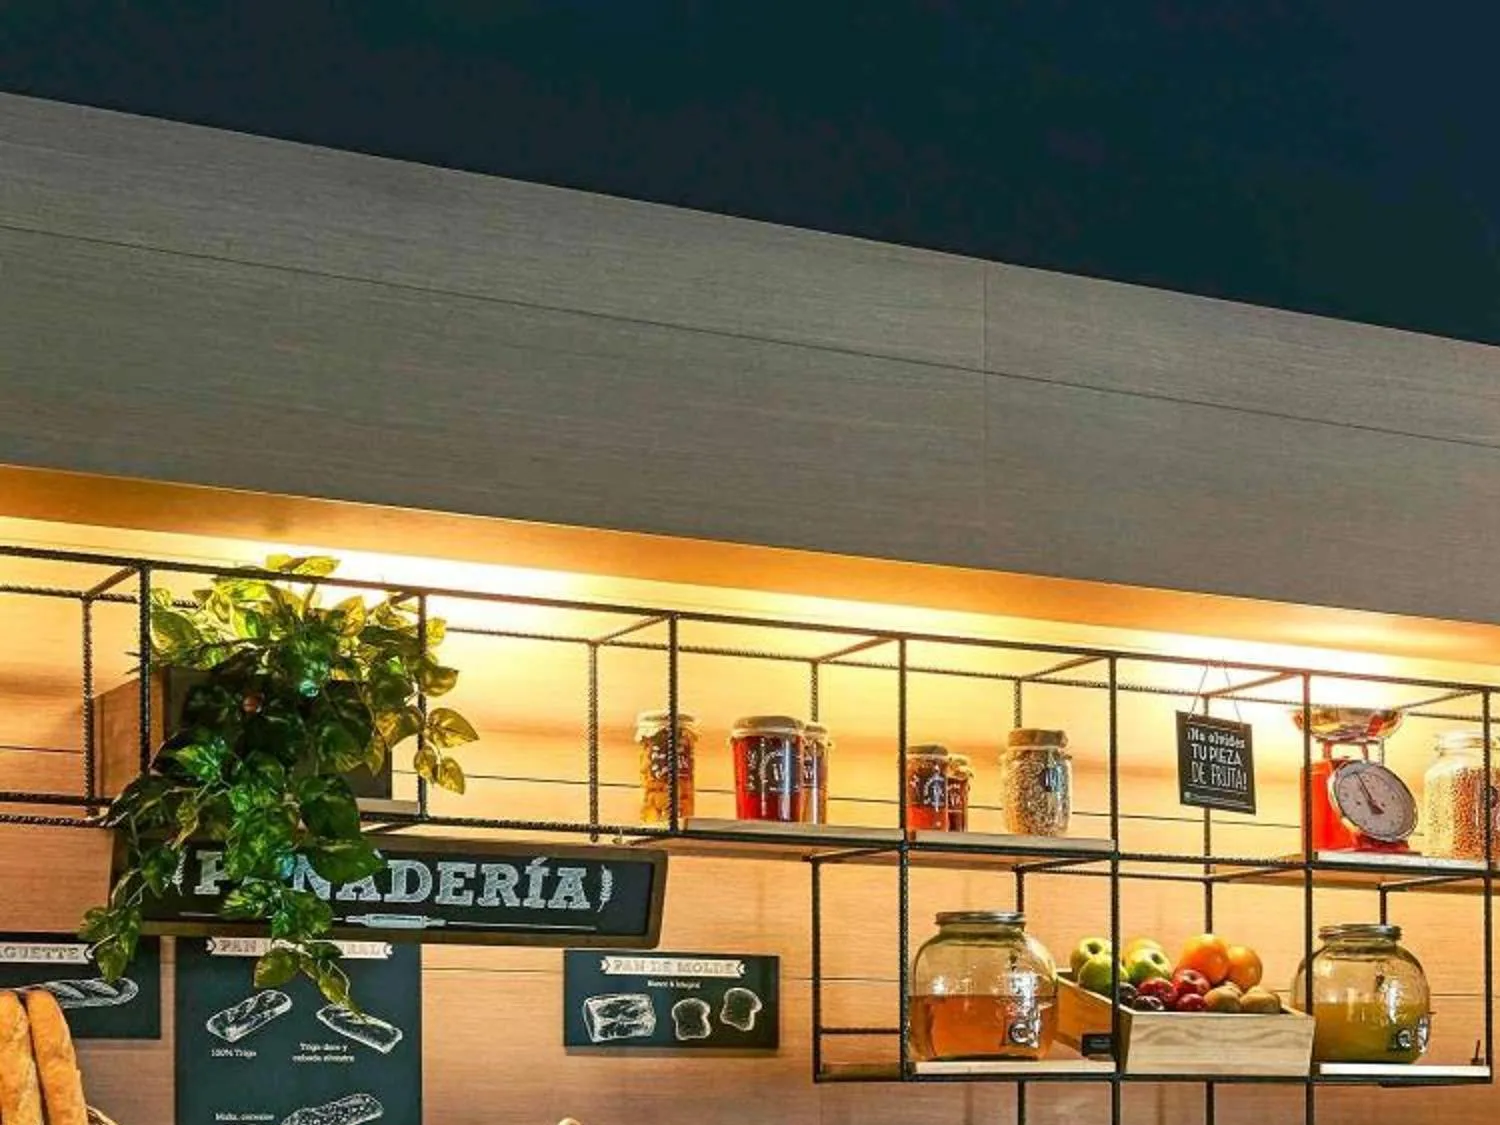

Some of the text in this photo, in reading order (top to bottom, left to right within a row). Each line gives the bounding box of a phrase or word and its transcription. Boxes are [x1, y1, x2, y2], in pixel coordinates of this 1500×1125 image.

[1191, 743, 1243, 766] TU PIEZA
[1191, 761, 1248, 791] DE FRUTA!
[194, 850, 592, 910] PNADERÍA
[0, 945, 80, 960] GUETTE
